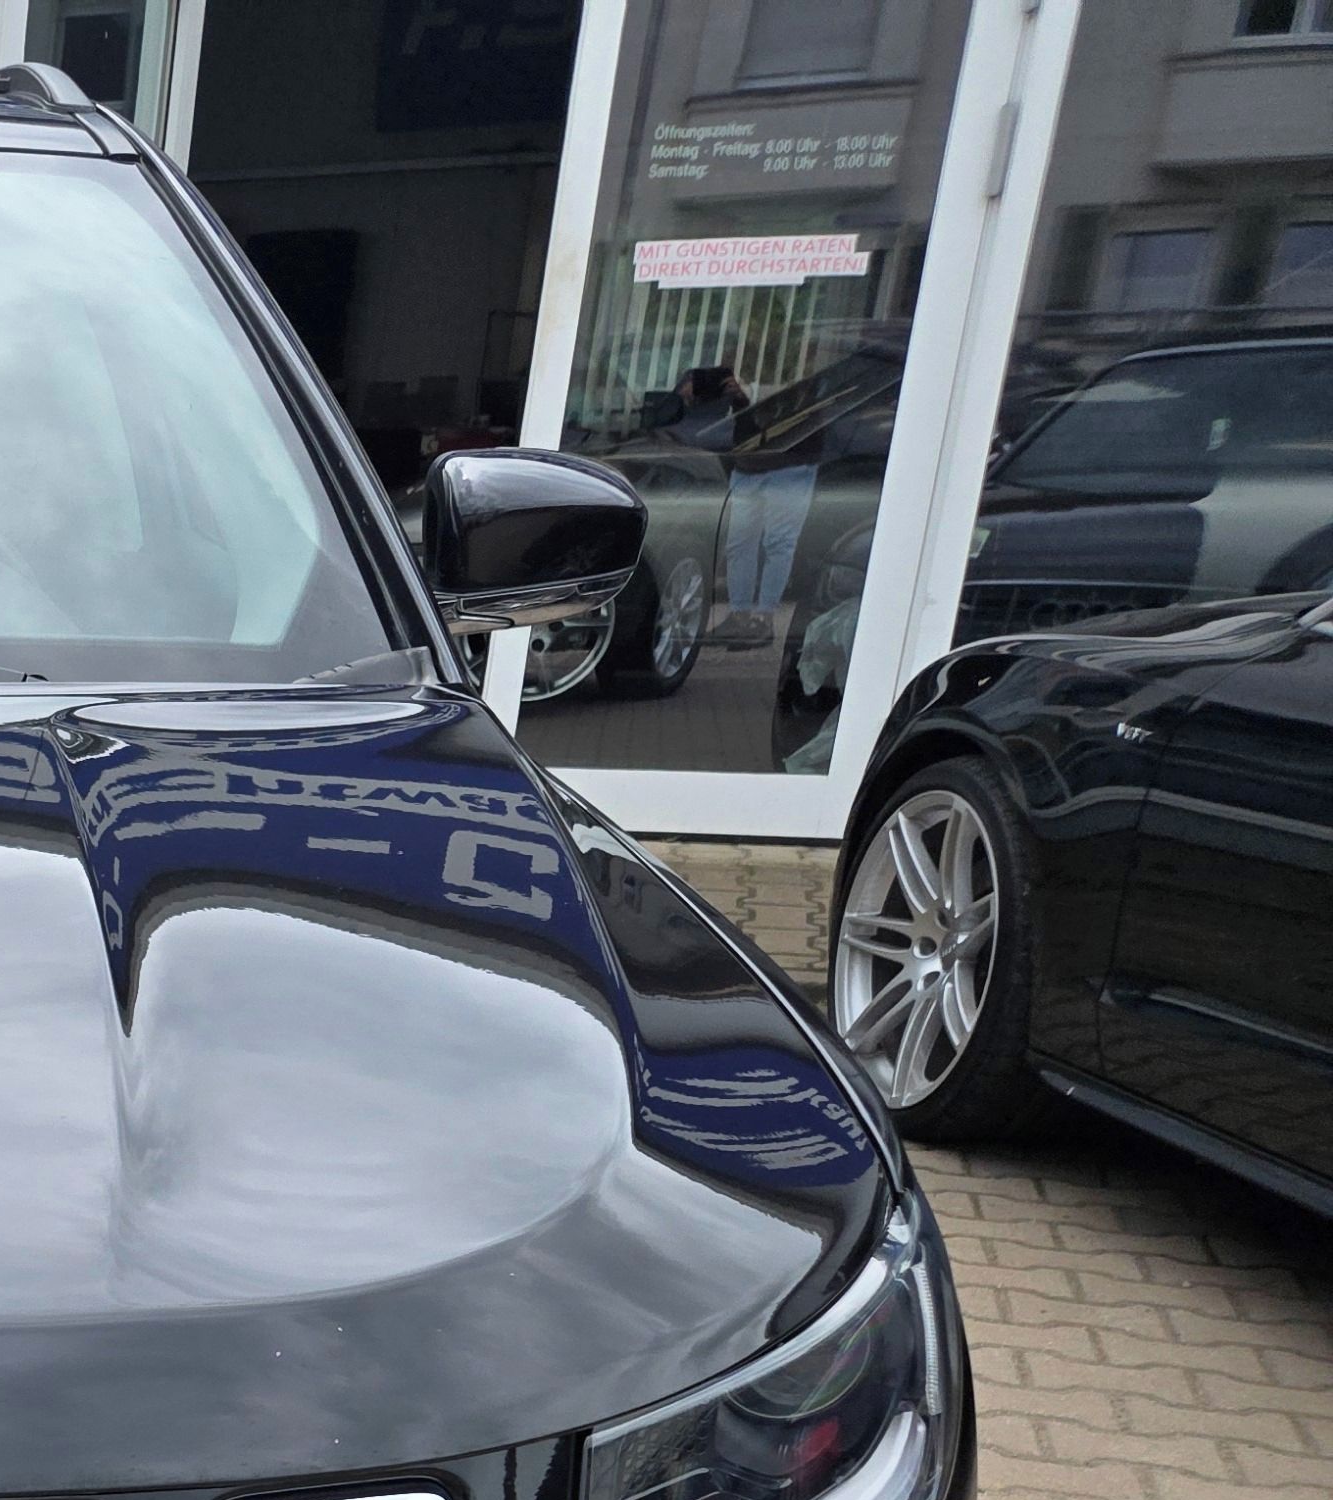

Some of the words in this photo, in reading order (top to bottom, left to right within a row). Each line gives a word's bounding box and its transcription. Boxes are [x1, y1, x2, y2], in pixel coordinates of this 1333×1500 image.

[650, 144, 700, 160] Montag
[796, 136, 821, 153] Uhr
[871, 132, 899, 150] Uhr
[793, 155, 818, 171] Uhr
[868, 150, 894, 168] Uhr
[637, 243, 672, 260] MIT
[792, 237, 853, 255] RATEN
[638, 261, 703, 279] DIREKT
[708, 256, 866, 275] DURCHSTARTEN!
